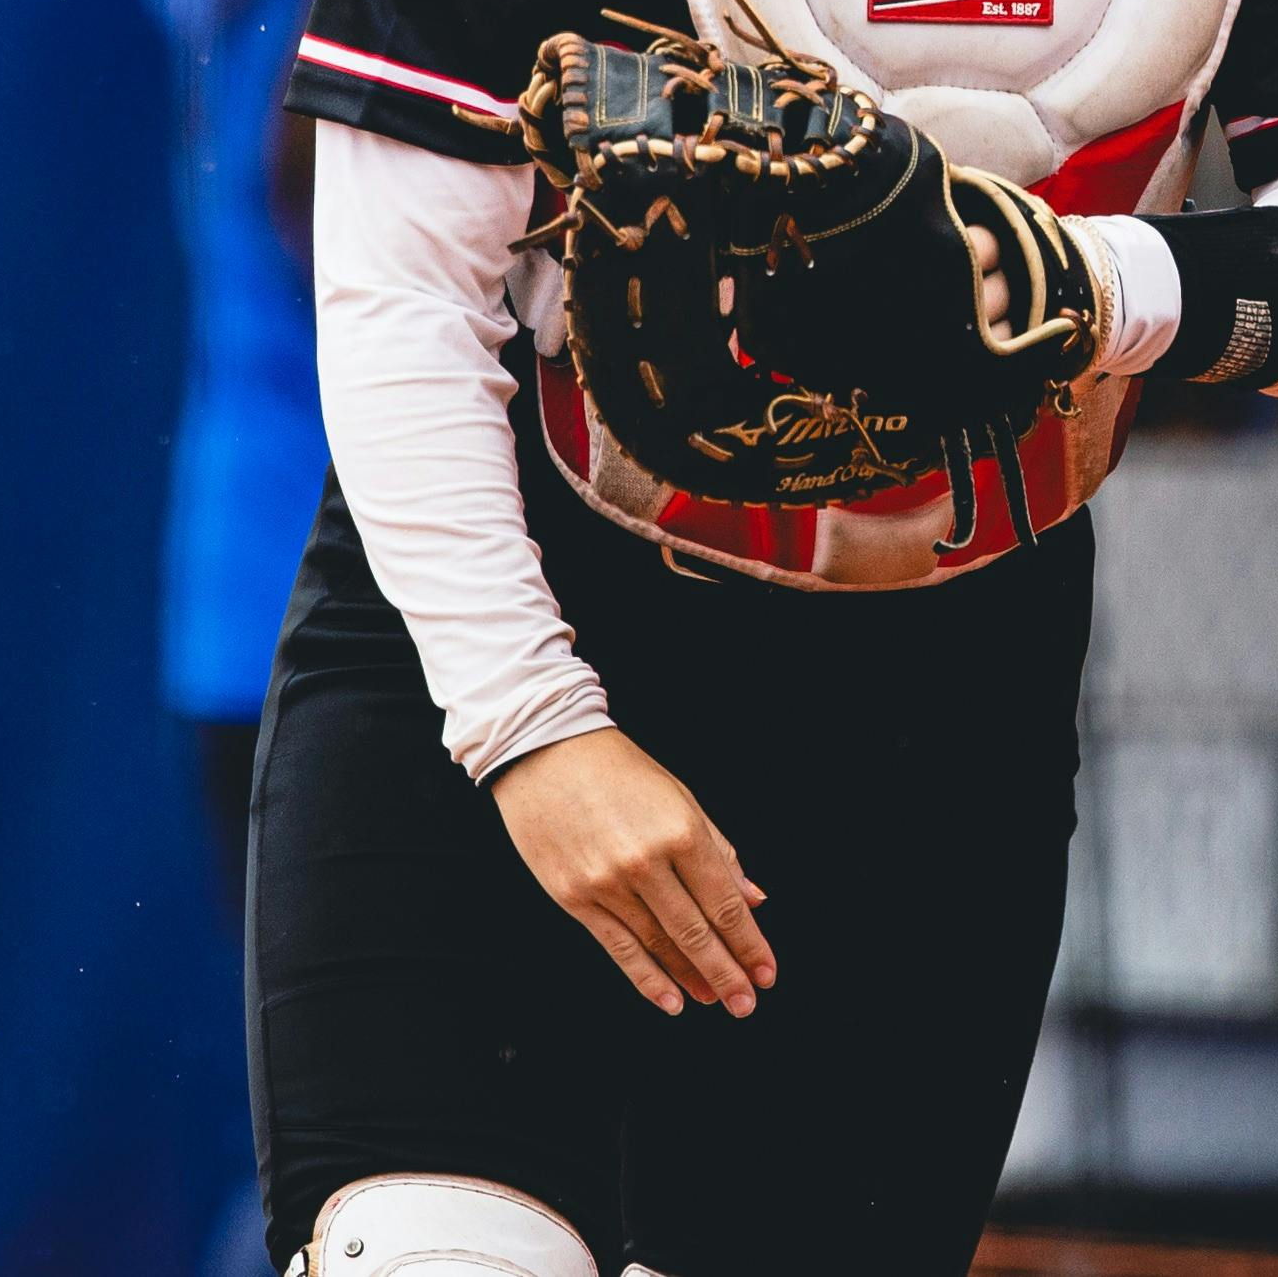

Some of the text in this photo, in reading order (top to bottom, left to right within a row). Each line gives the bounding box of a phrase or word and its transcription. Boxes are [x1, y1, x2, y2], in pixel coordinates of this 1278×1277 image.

[982, 1, 1041, 16] Est. 1887
[776, 415, 908, 445] Mizno
